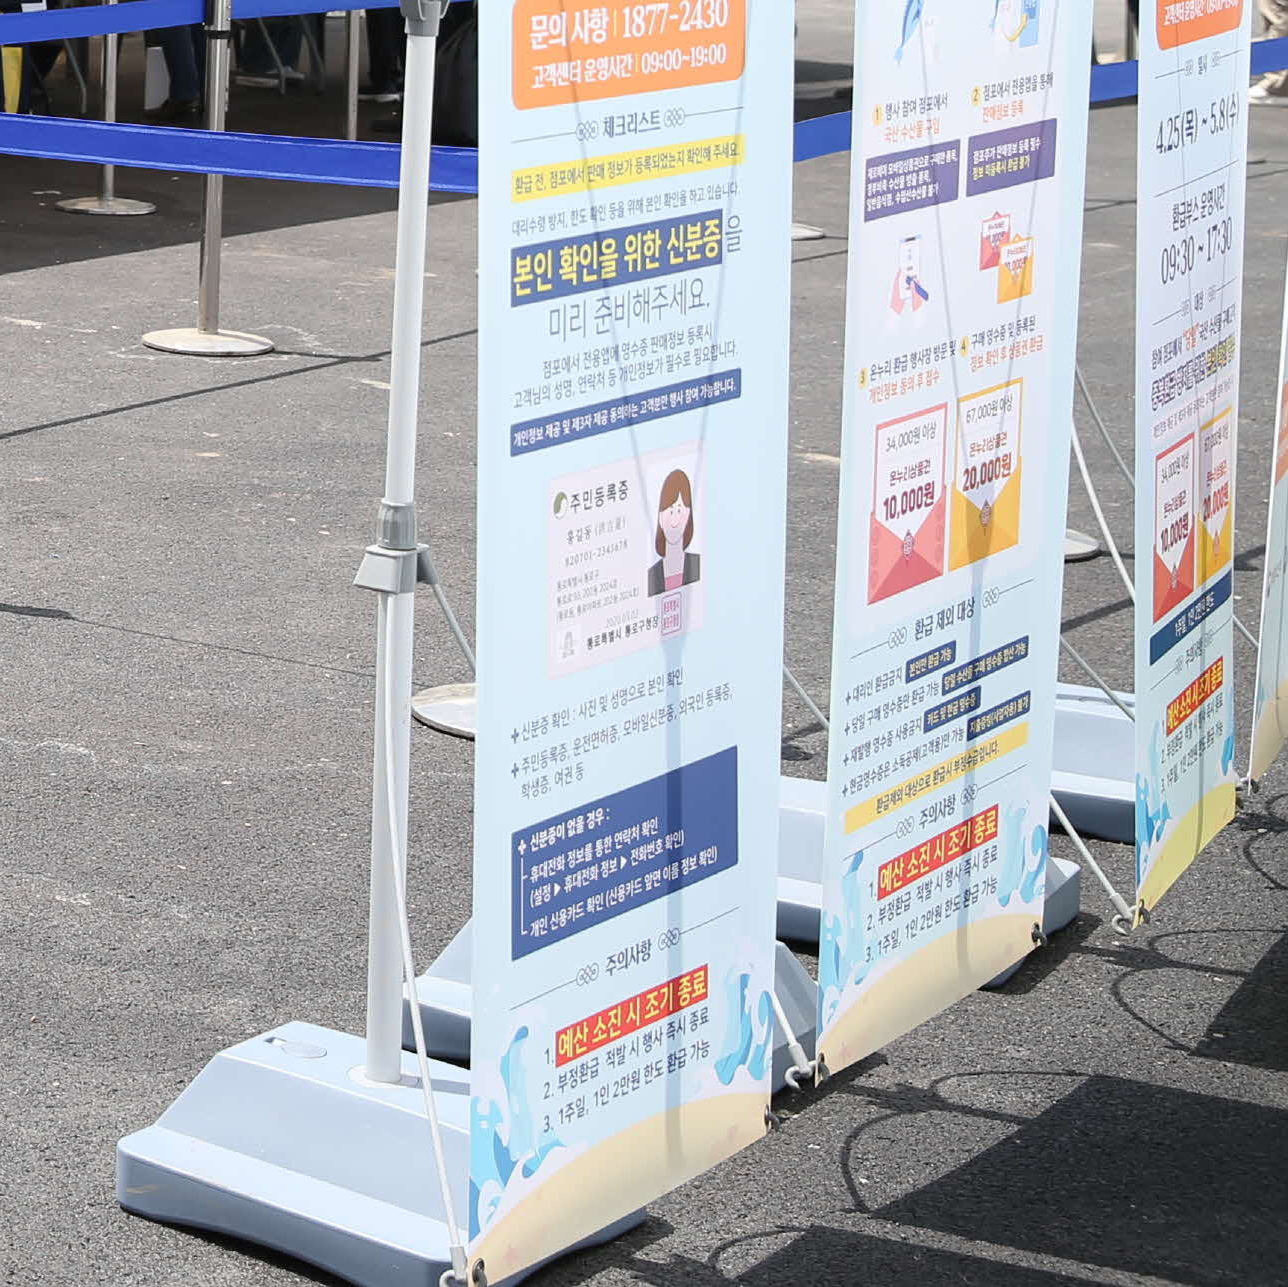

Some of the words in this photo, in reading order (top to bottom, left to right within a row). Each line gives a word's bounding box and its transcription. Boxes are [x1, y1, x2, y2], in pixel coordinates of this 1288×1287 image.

[529, 12, 567, 50] 문의
[572, 6, 609, 45] 사항
[531, 58, 581, 88] 고객센터
[585, 53, 633, 82] 운영시간
[642, 42, 727, 75] 09:00~19:00
[603, 110, 661, 138] 체크리스트
[1156, 107, 1198, 154] 4.25(목)
[1210, 91, 1240, 135] 5.8(수)
[1172, 200, 1199, 232] 환급부스
[1201, 183, 1225, 219] 운영시간
[513, 248, 552, 296] 본인
[559, 238, 619, 285] 확인을
[623, 229, 661, 272] 위한
[1161, 234, 1194, 285] 09:30
[1207, 216, 1232, 262] 17:30
[549, 300, 587, 342] 미리
[594, 277, 710, 335] 준비해주세요.
[966, 401, 998, 424] 67,000원
[1000, 394, 1013, 412] 이상
[885, 427, 920, 452] 34,000원
[922, 422, 936, 440] 이상
[969, 432, 1007, 457] 온누리상품권
[889, 459, 931, 488] 온누리상품권
[963, 452, 1012, 492] 20,000원
[883, 480, 935, 520] 10,000원
[1203, 482, 1229, 523] 20,000원
[1161, 512, 1189, 554] 10,000원
[915, 616, 933, 641] 환급
[936, 607, 954, 630] 제외
[957, 596, 975, 620] 대상
[521, 720, 549, 743] 신분증
[552, 708, 570, 729] 확인
[578, 699, 596, 721] 사진
[599, 695, 608, 714] 및
[611, 682, 646, 710] 성명으로
[648, 674, 664, 696] 본인
[667, 666, 683, 690] 확인
[521, 778, 552, 799] 학생증,
[555, 768, 572, 787] 여권
[576, 762, 584, 781] 등
[530, 826, 565, 853] 신분증이
[567, 818, 584, 841] 없을
[587, 809, 604, 831] 경우
[919, 793, 956, 830] 주의사항
[530, 855, 566, 883] 휴대전화
[567, 846, 592, 868] 정보를
[595, 837, 612, 858] 통한
[614, 827, 640, 850] 연락처
[641, 816, 658, 839] 확인
[880, 860, 903, 892] 예산
[906, 847, 931, 879] 소진
[934, 835, 945, 864] 시
[948, 821, 971, 852] 조기
[974, 809, 997, 844] 종료
[606, 939, 652, 976] 주의사항
[544, 1048, 554, 1065] 1.
[558, 1022, 590, 1059] 예산
[592, 1010, 622, 1044] 소진
[626, 1001, 641, 1030] 시
[644, 986, 674, 1018] 조기
[678, 969, 707, 1006] 종료
[544, 1082, 554, 1100] 2.
[558, 1059, 599, 1091] 부정환급
[606, 1045, 626, 1069] 적발
[629, 1038, 640, 1059] 시
[643, 1026, 663, 1053] 행사
[665, 1017, 686, 1043] 즉시
[689, 1007, 710, 1033] 종료
[544, 1114, 554, 1133] 3.
[559, 1095, 590, 1125] 1주일,
[594, 1085, 609, 1108] 1인
[613, 1069, 641, 1099] 2만원
[644, 1059, 663, 1083] 한도
[666, 1050, 687, 1073] 환급
[689, 1040, 711, 1062] 가능
